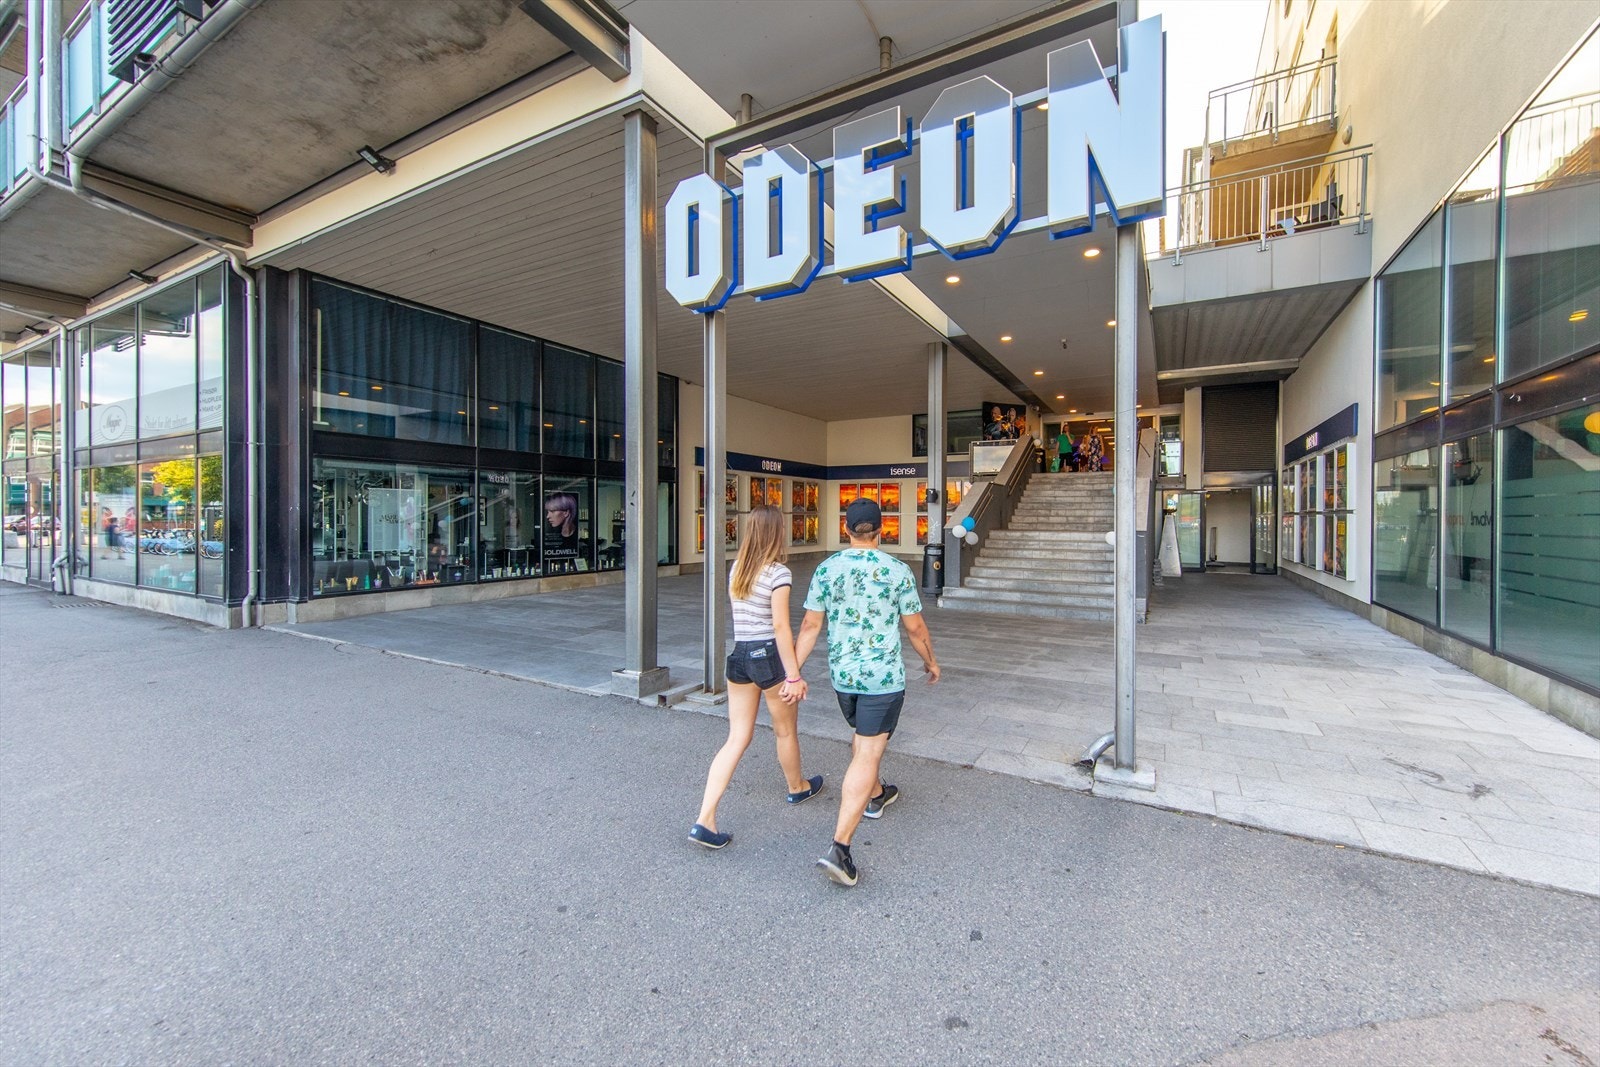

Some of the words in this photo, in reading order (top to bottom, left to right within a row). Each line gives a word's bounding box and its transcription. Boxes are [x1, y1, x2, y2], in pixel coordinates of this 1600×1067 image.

[665, 14, 1166, 313] ODEON
[761, 459, 782, 473] ODEON
[890, 466, 916, 476] isense
